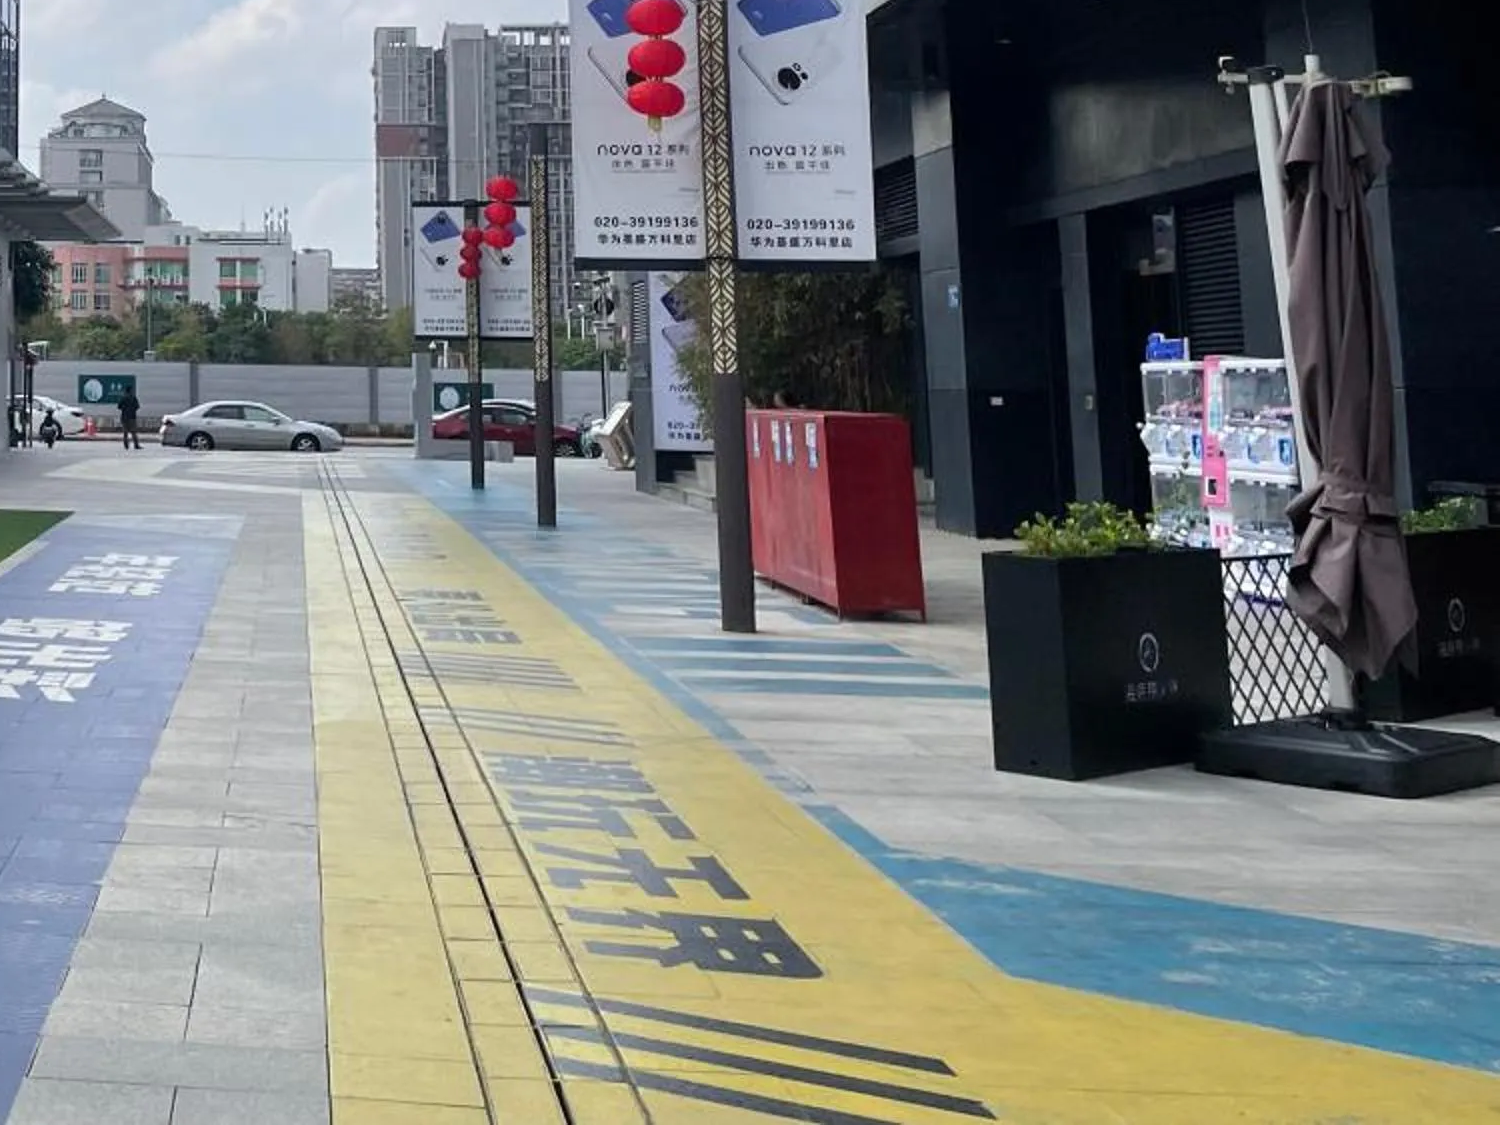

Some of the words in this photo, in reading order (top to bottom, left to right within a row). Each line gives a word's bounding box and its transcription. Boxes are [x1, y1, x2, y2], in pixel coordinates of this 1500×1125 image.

[597, 143, 642, 156] nova
[648, 144, 662, 156] 12
[749, 145, 797, 156] nova
[801, 145, 817, 156] 12
[594, 216, 699, 228] 020-39199136
[747, 218, 856, 230] 020-39199136
